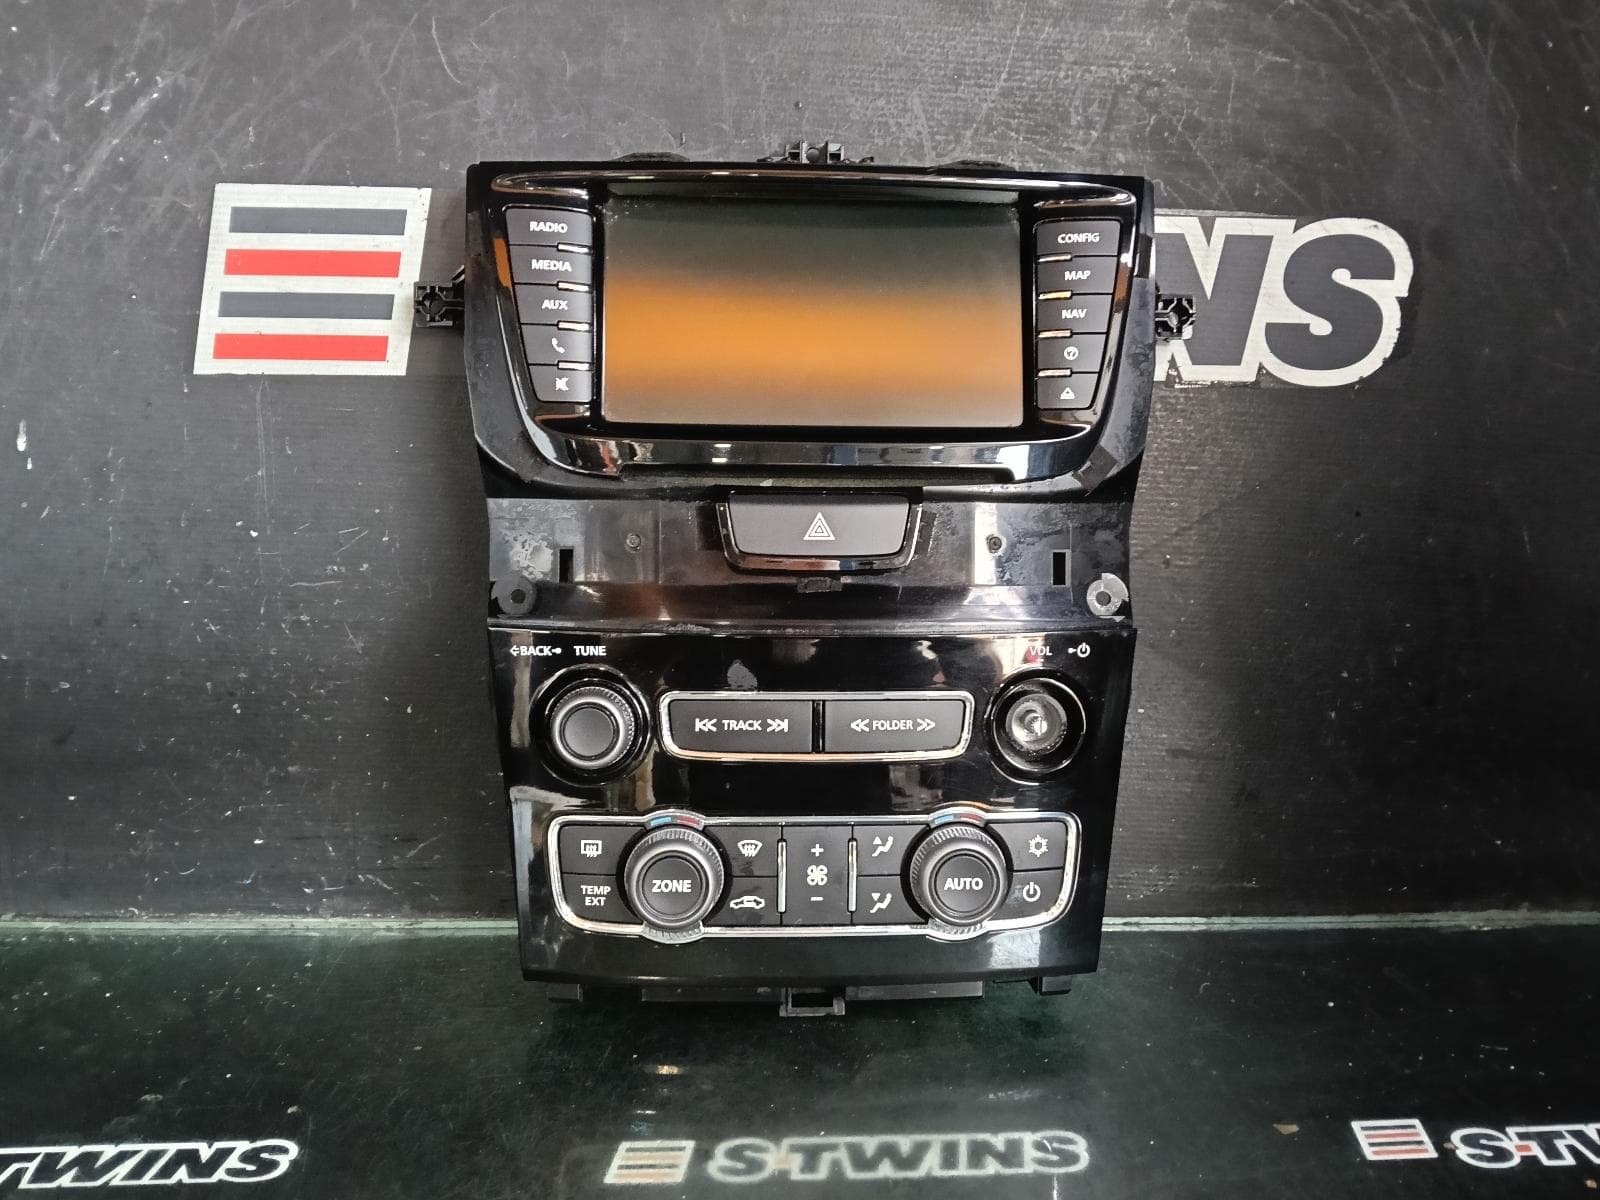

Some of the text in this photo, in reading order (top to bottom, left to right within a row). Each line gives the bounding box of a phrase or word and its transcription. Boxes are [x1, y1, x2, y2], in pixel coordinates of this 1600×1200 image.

[530, 221, 568, 233] RADIO
[1057, 232, 1100, 243] CONFIG
[531, 259, 572, 272] MEDIA
[1064, 270, 1091, 281] MAP
[541, 299, 569, 311] AUX
[1061, 308, 1087, 319] NAV
[520, 645, 552, 657] BACK
[573, 645, 607, 657] TUNE
[1029, 645, 1053, 657] VOL
[722, 719, 762, 731] TRACK
[872, 719, 913, 731] FOLDER
[651, 879, 692, 893] ZONE
[943, 877, 984, 891] AUTO
[580, 885, 611, 896] TEMP
[585, 896, 606, 907] EXT
